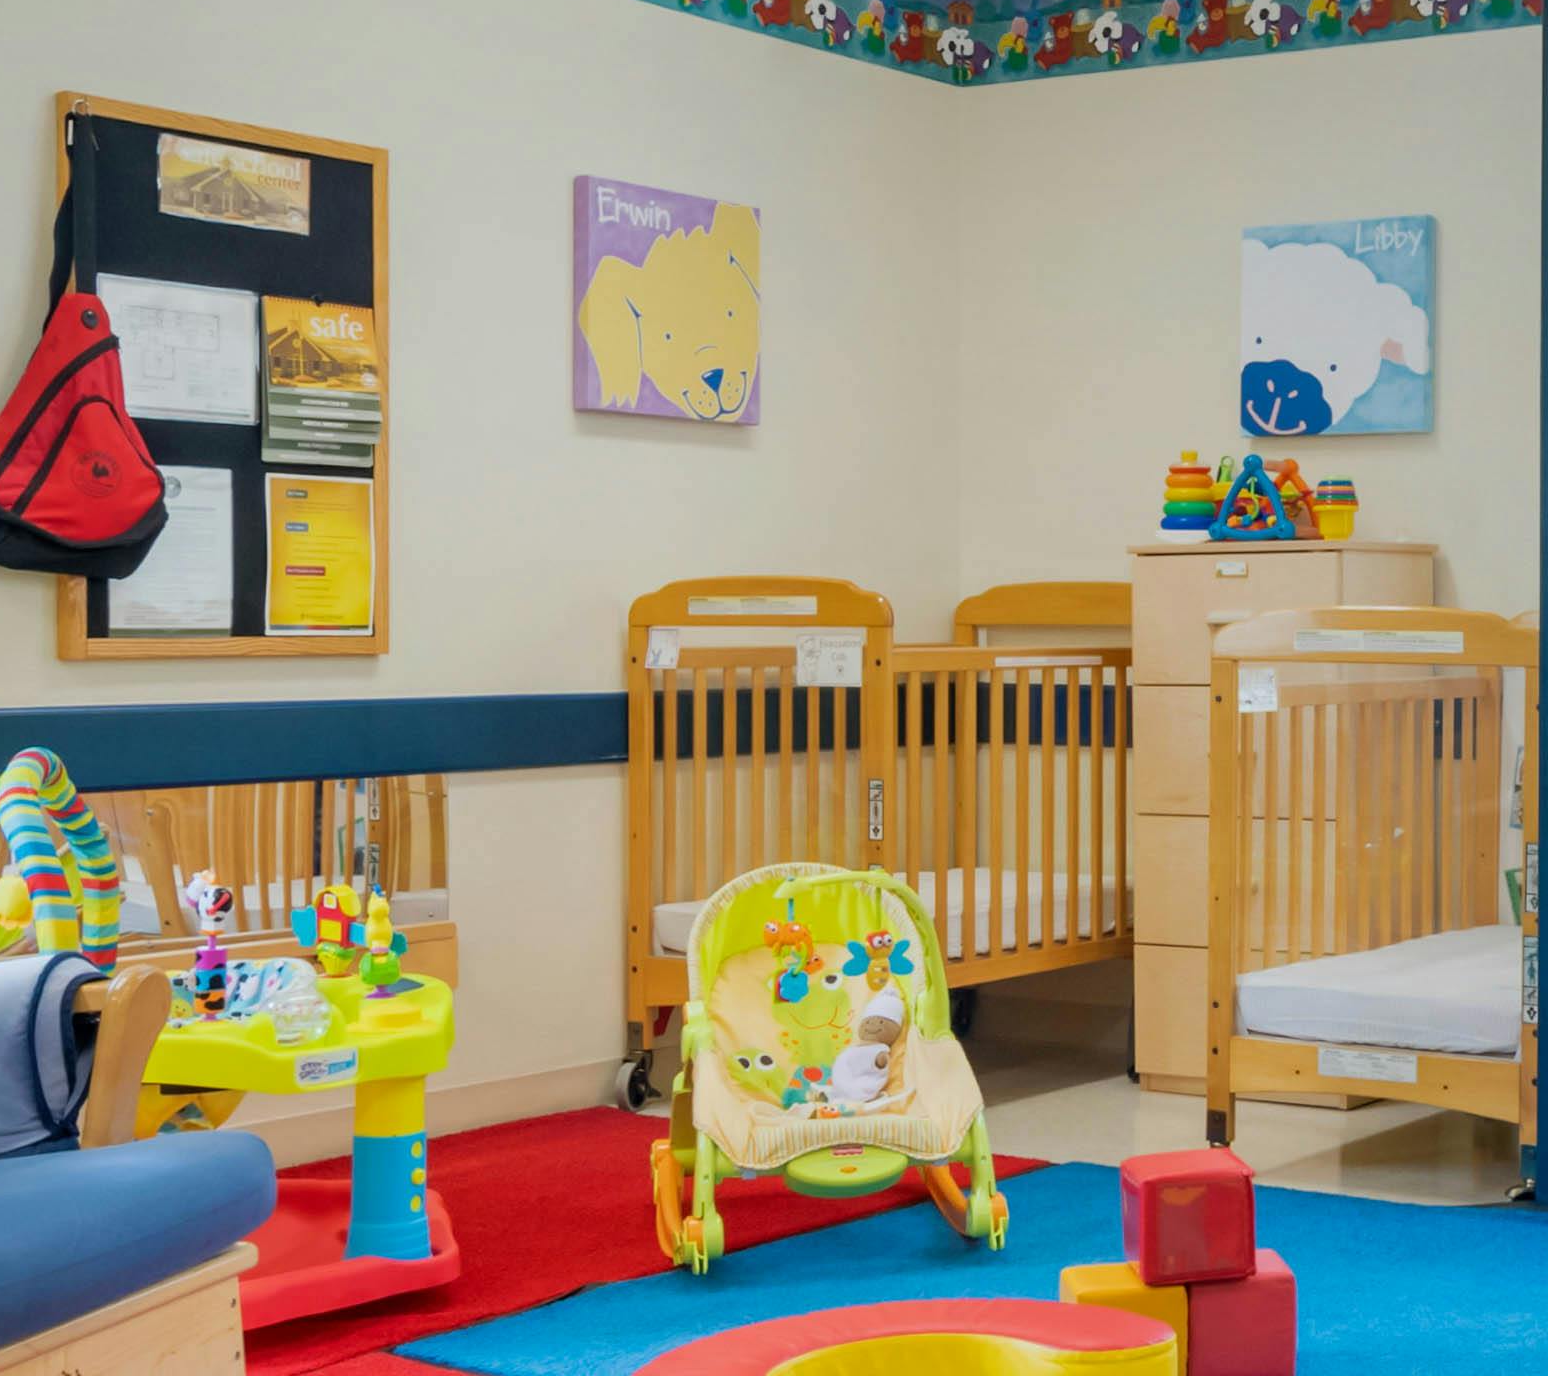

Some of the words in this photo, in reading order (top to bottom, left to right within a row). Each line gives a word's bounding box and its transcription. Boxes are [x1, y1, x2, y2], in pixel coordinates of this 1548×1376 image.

[596, 186, 671, 231] Erwin
[1355, 220, 1424, 257] Libby
[309, 312, 365, 341] safe
